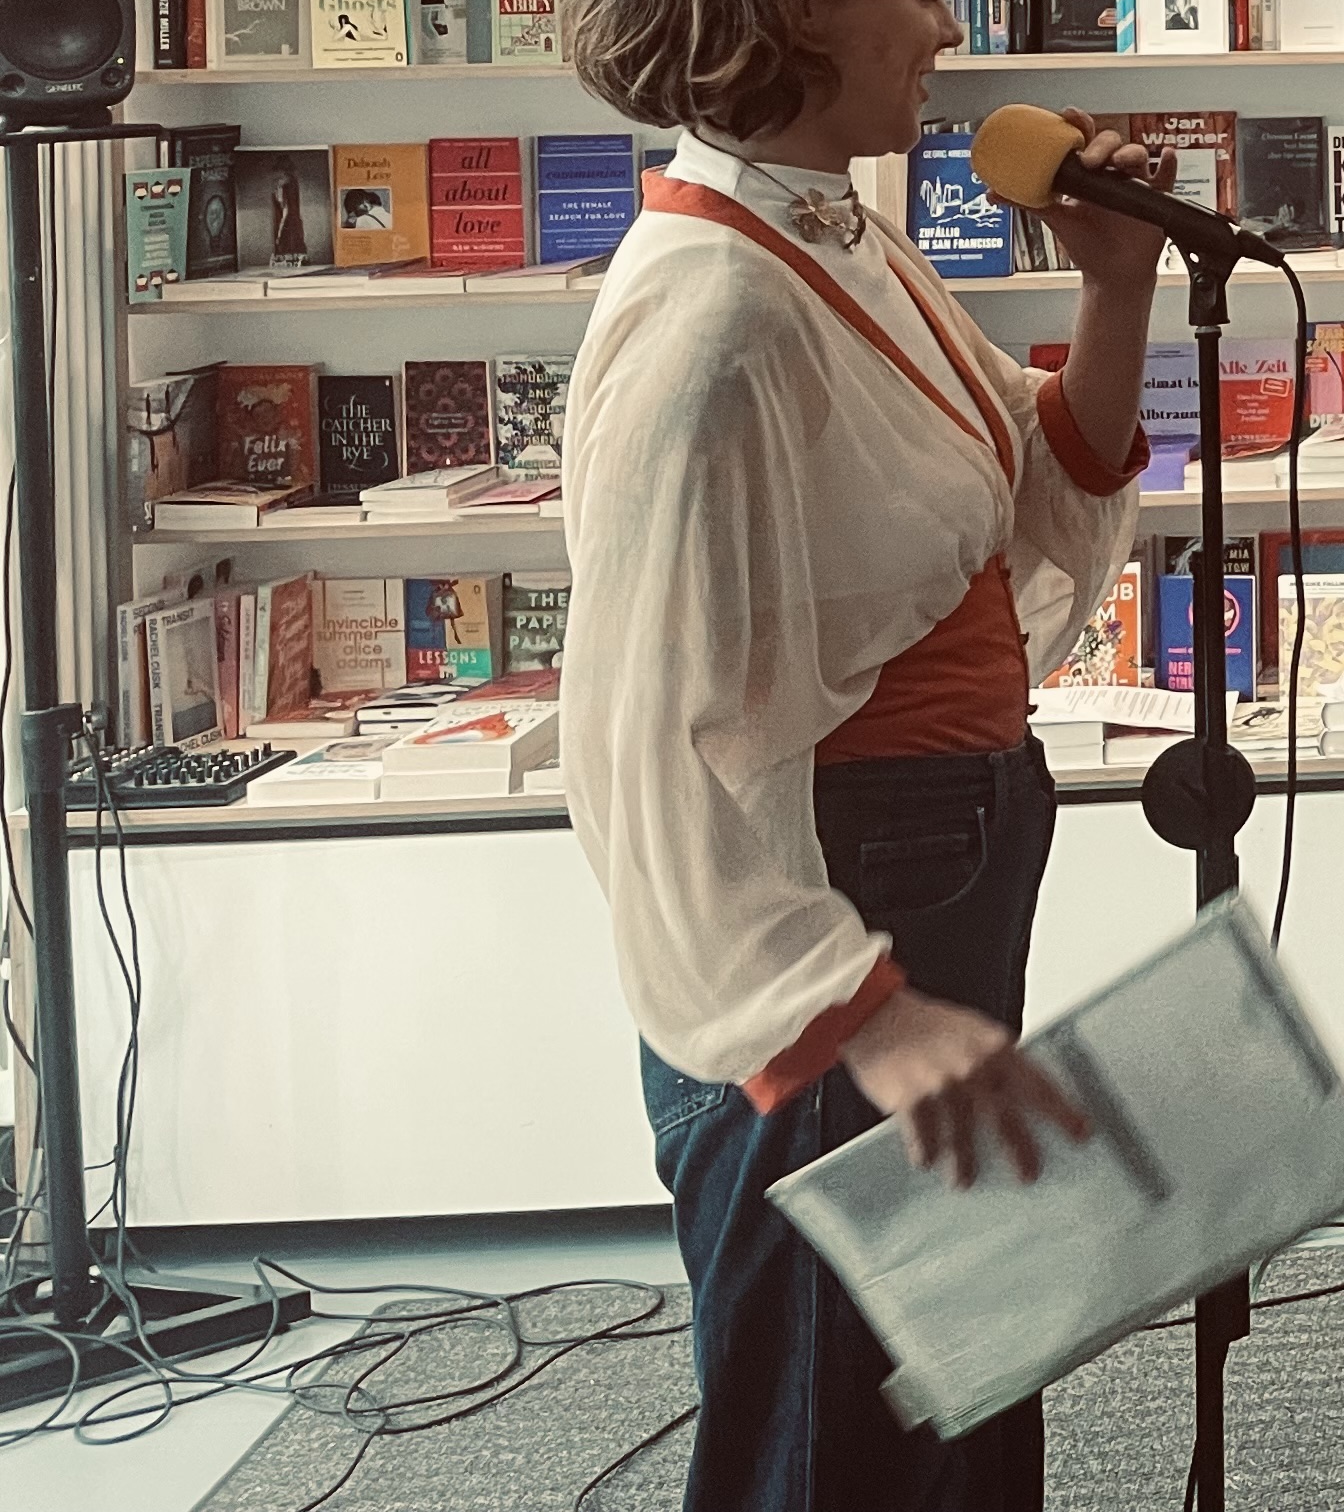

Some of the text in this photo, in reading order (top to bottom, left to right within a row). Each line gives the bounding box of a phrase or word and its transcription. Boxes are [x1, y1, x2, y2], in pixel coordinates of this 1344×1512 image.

[159, 18, 170, 50] MILLER
[1164, 117, 1205, 130] Jan
[1141, 131, 1229, 148] Wagner
[460, 147, 492, 170] all
[442, 183, 510, 203] about
[453, 212, 503, 235] love
[918, 223, 961, 239] ZUFÄLLIG
[918, 237, 1004, 250] IN SAN FRANCISCO
[1255, 359, 1289, 374] Zeit
[528, 389, 552, 398] AND
[340, 394, 371, 418] THE
[321, 418, 394, 433] CATCHER
[244, 436, 287, 455] Felix
[330, 431, 385, 447] IN THE
[247, 454, 285, 472] Ever
[342, 445, 373, 471] RYE
[529, 592, 568, 608] THE
[161, 608, 195, 627] TRANSIT
[321, 616, 400, 631] invincible
[316, 630, 381, 641] summer
[148, 618, 161, 689] RACHEL CUSK
[343, 642, 384, 656] alice
[336, 656, 393, 670] adams
[418, 649, 478, 666] LESSONS
